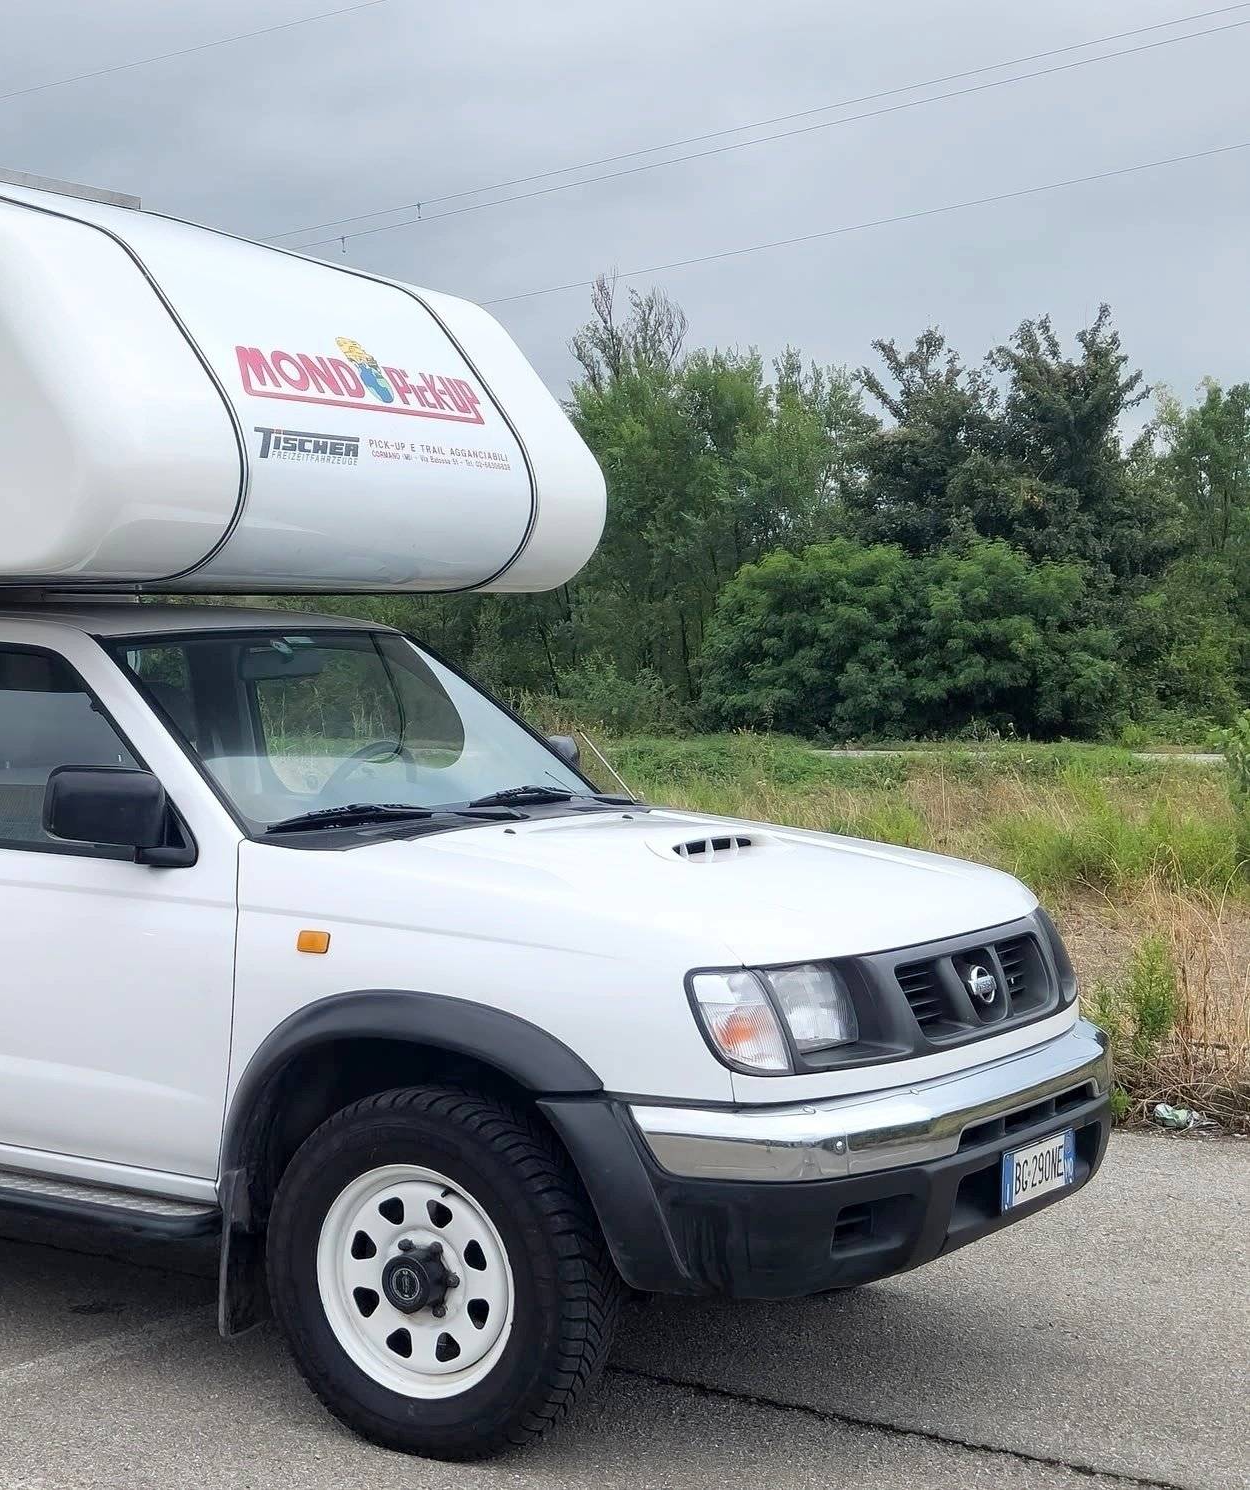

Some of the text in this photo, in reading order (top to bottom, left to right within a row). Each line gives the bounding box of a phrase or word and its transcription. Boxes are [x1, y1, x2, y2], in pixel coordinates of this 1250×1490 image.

[271, 450, 358, 466] FREIZEITFAHRZEUGE
[368, 439, 509, 462] PICK-UP E TRAIL AGGANCIABILI
